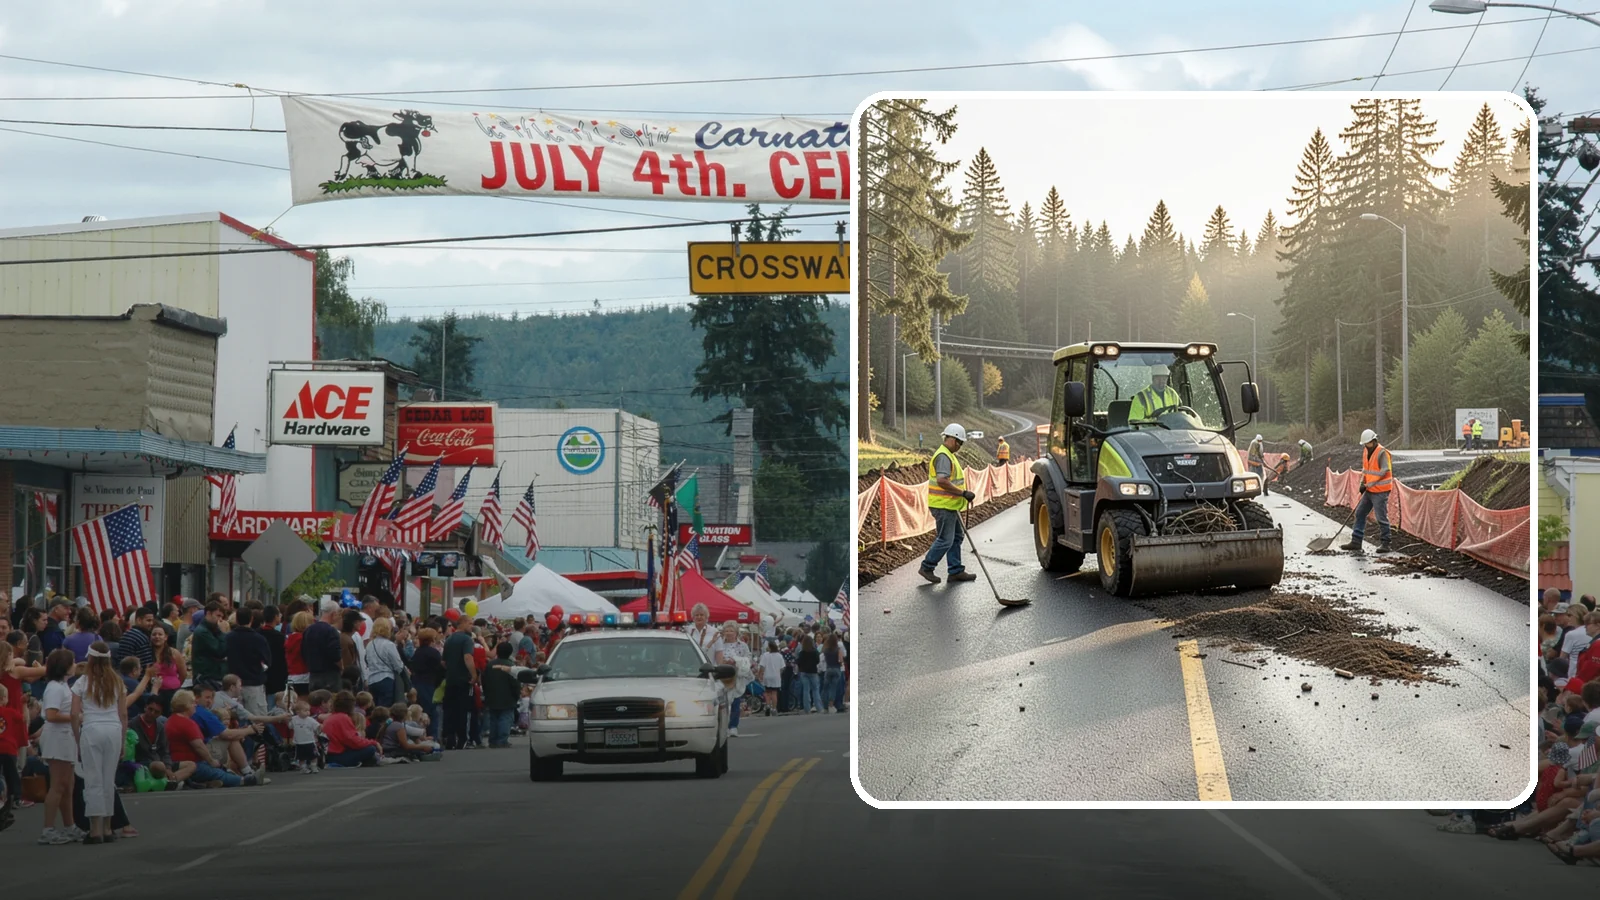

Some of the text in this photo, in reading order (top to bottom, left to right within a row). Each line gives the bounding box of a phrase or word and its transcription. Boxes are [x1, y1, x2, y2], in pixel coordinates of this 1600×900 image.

[481, 140, 605, 193] JULY
[632, 149, 746, 198] 4th.
[696, 254, 850, 280] CROSSWA
[283, 380, 373, 420] ACE
[405, 410, 485, 422] CEDAR LOG
[283, 421, 370, 436] Hardware
[416, 428, 477, 447] Coca-Cola
[353, 467, 384, 478] Simpl
[83, 484, 155, 496] St. Vincent de Paul
[688, 526, 742, 535] CRNATION
[699, 535, 730, 543] GLASS
